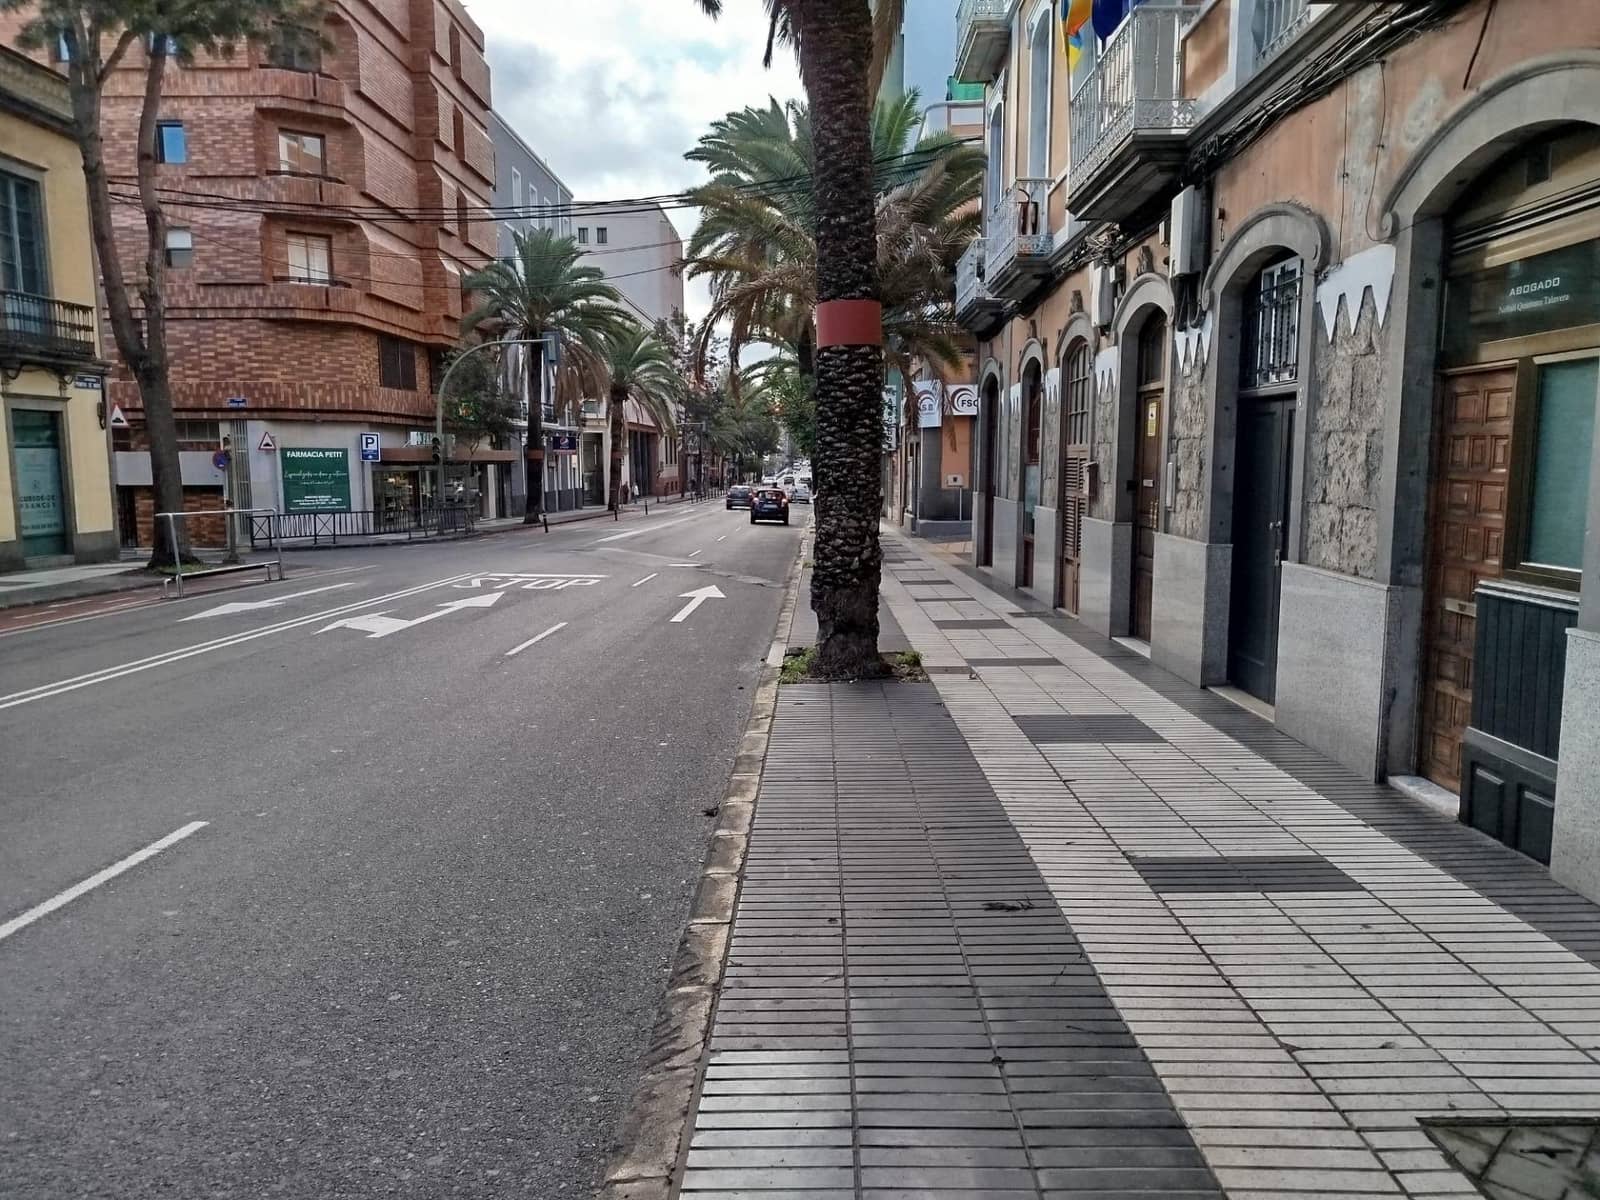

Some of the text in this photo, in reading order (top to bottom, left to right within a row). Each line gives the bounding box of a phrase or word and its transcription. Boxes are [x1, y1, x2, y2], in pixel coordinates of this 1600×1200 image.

[1508, 277, 1561, 297] ABOGADO
[365, 437, 375, 448] P
[452, 577, 602, 590] STOP
